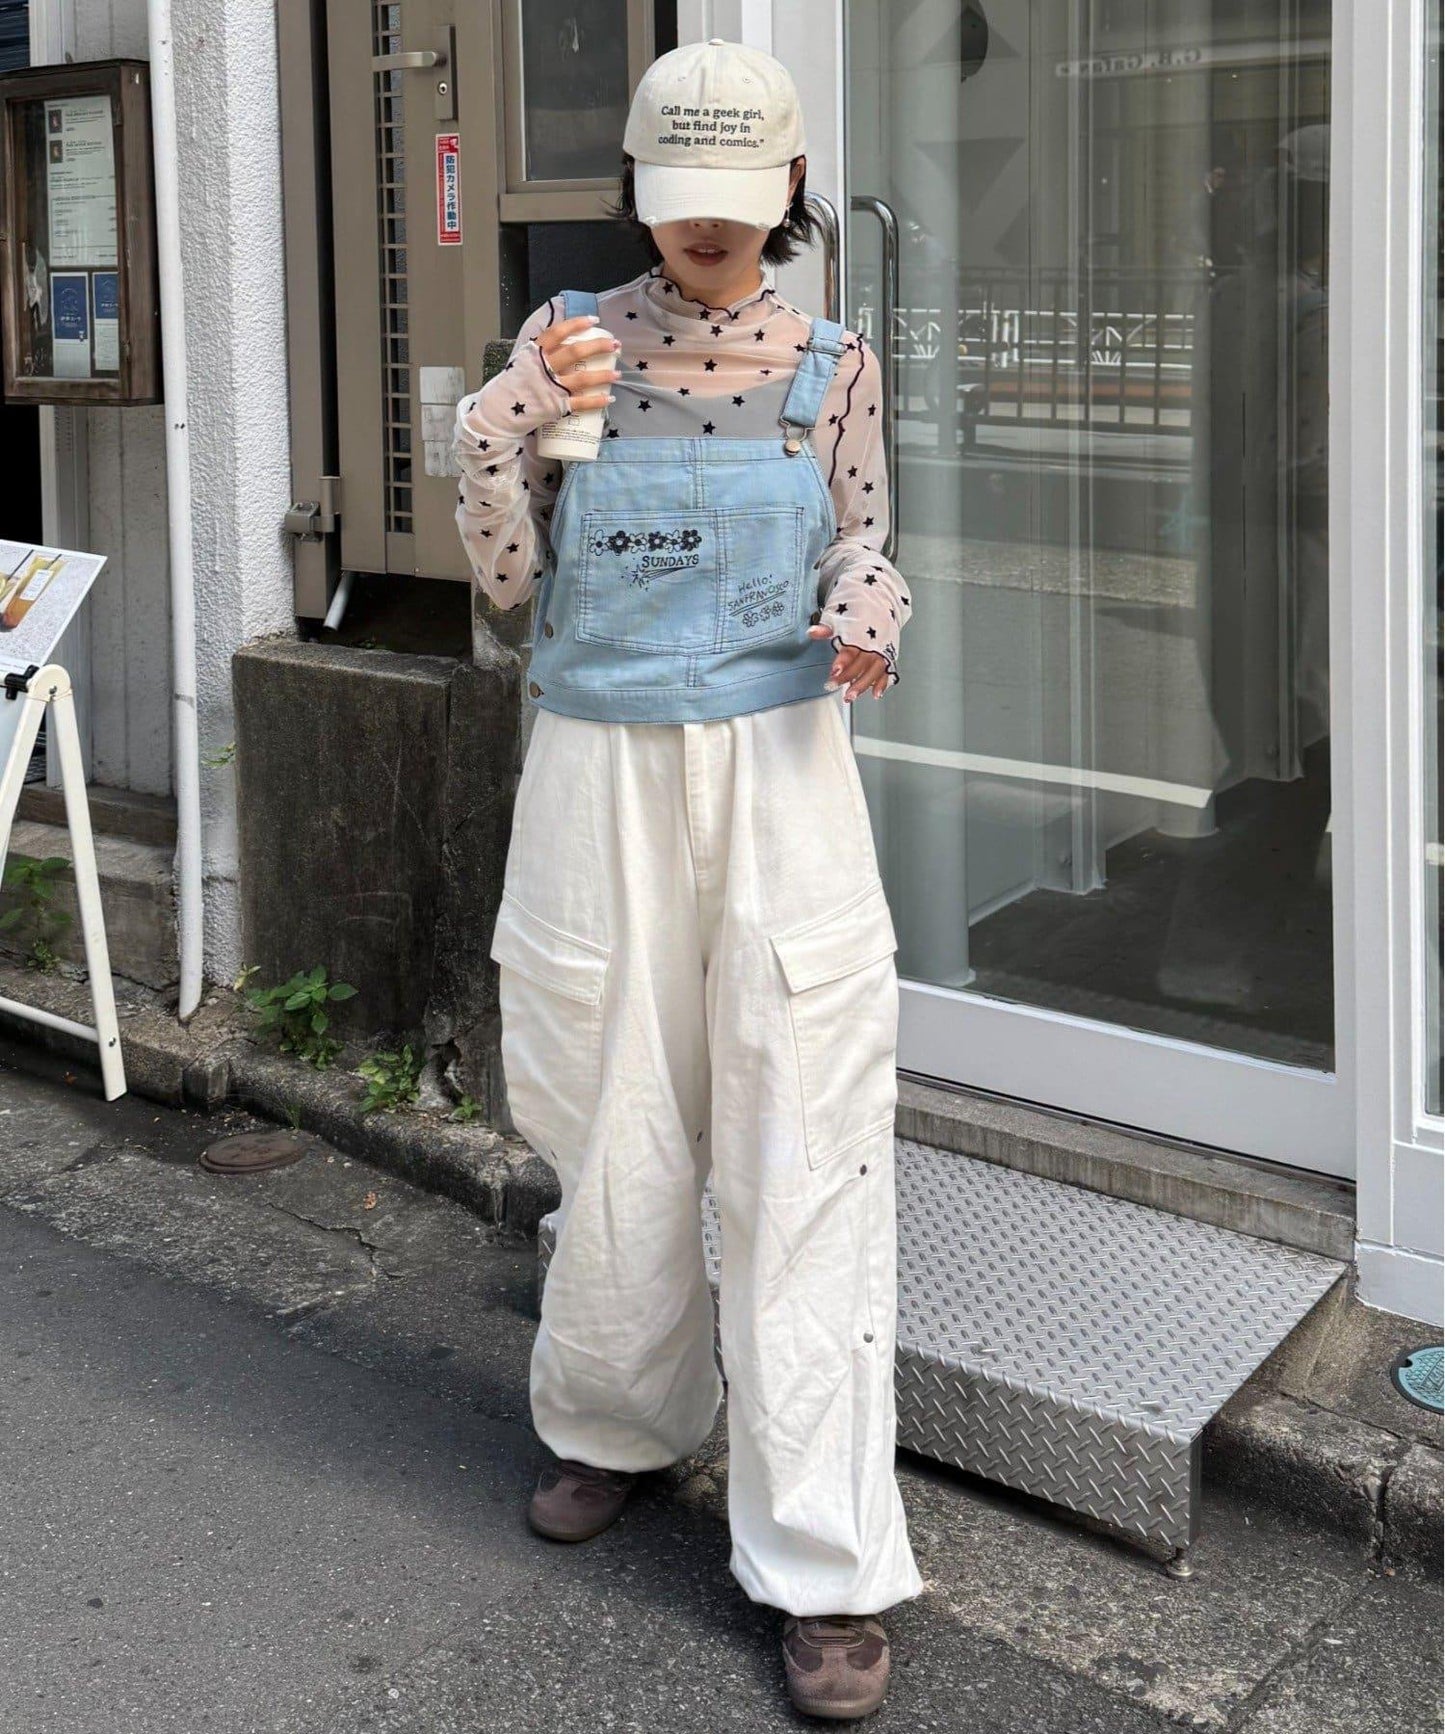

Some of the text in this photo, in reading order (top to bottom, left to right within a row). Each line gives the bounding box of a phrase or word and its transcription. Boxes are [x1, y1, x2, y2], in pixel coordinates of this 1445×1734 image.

[661, 105, 765, 121] Call me a geek girl,
[672, 119, 751, 135] but find joy in
[658, 134, 692, 147] coding
[694, 135, 717, 147] and
[446, 155, 457, 229] 防犯カメラ作動中
[642, 554, 699, 568] SUNDAYS
